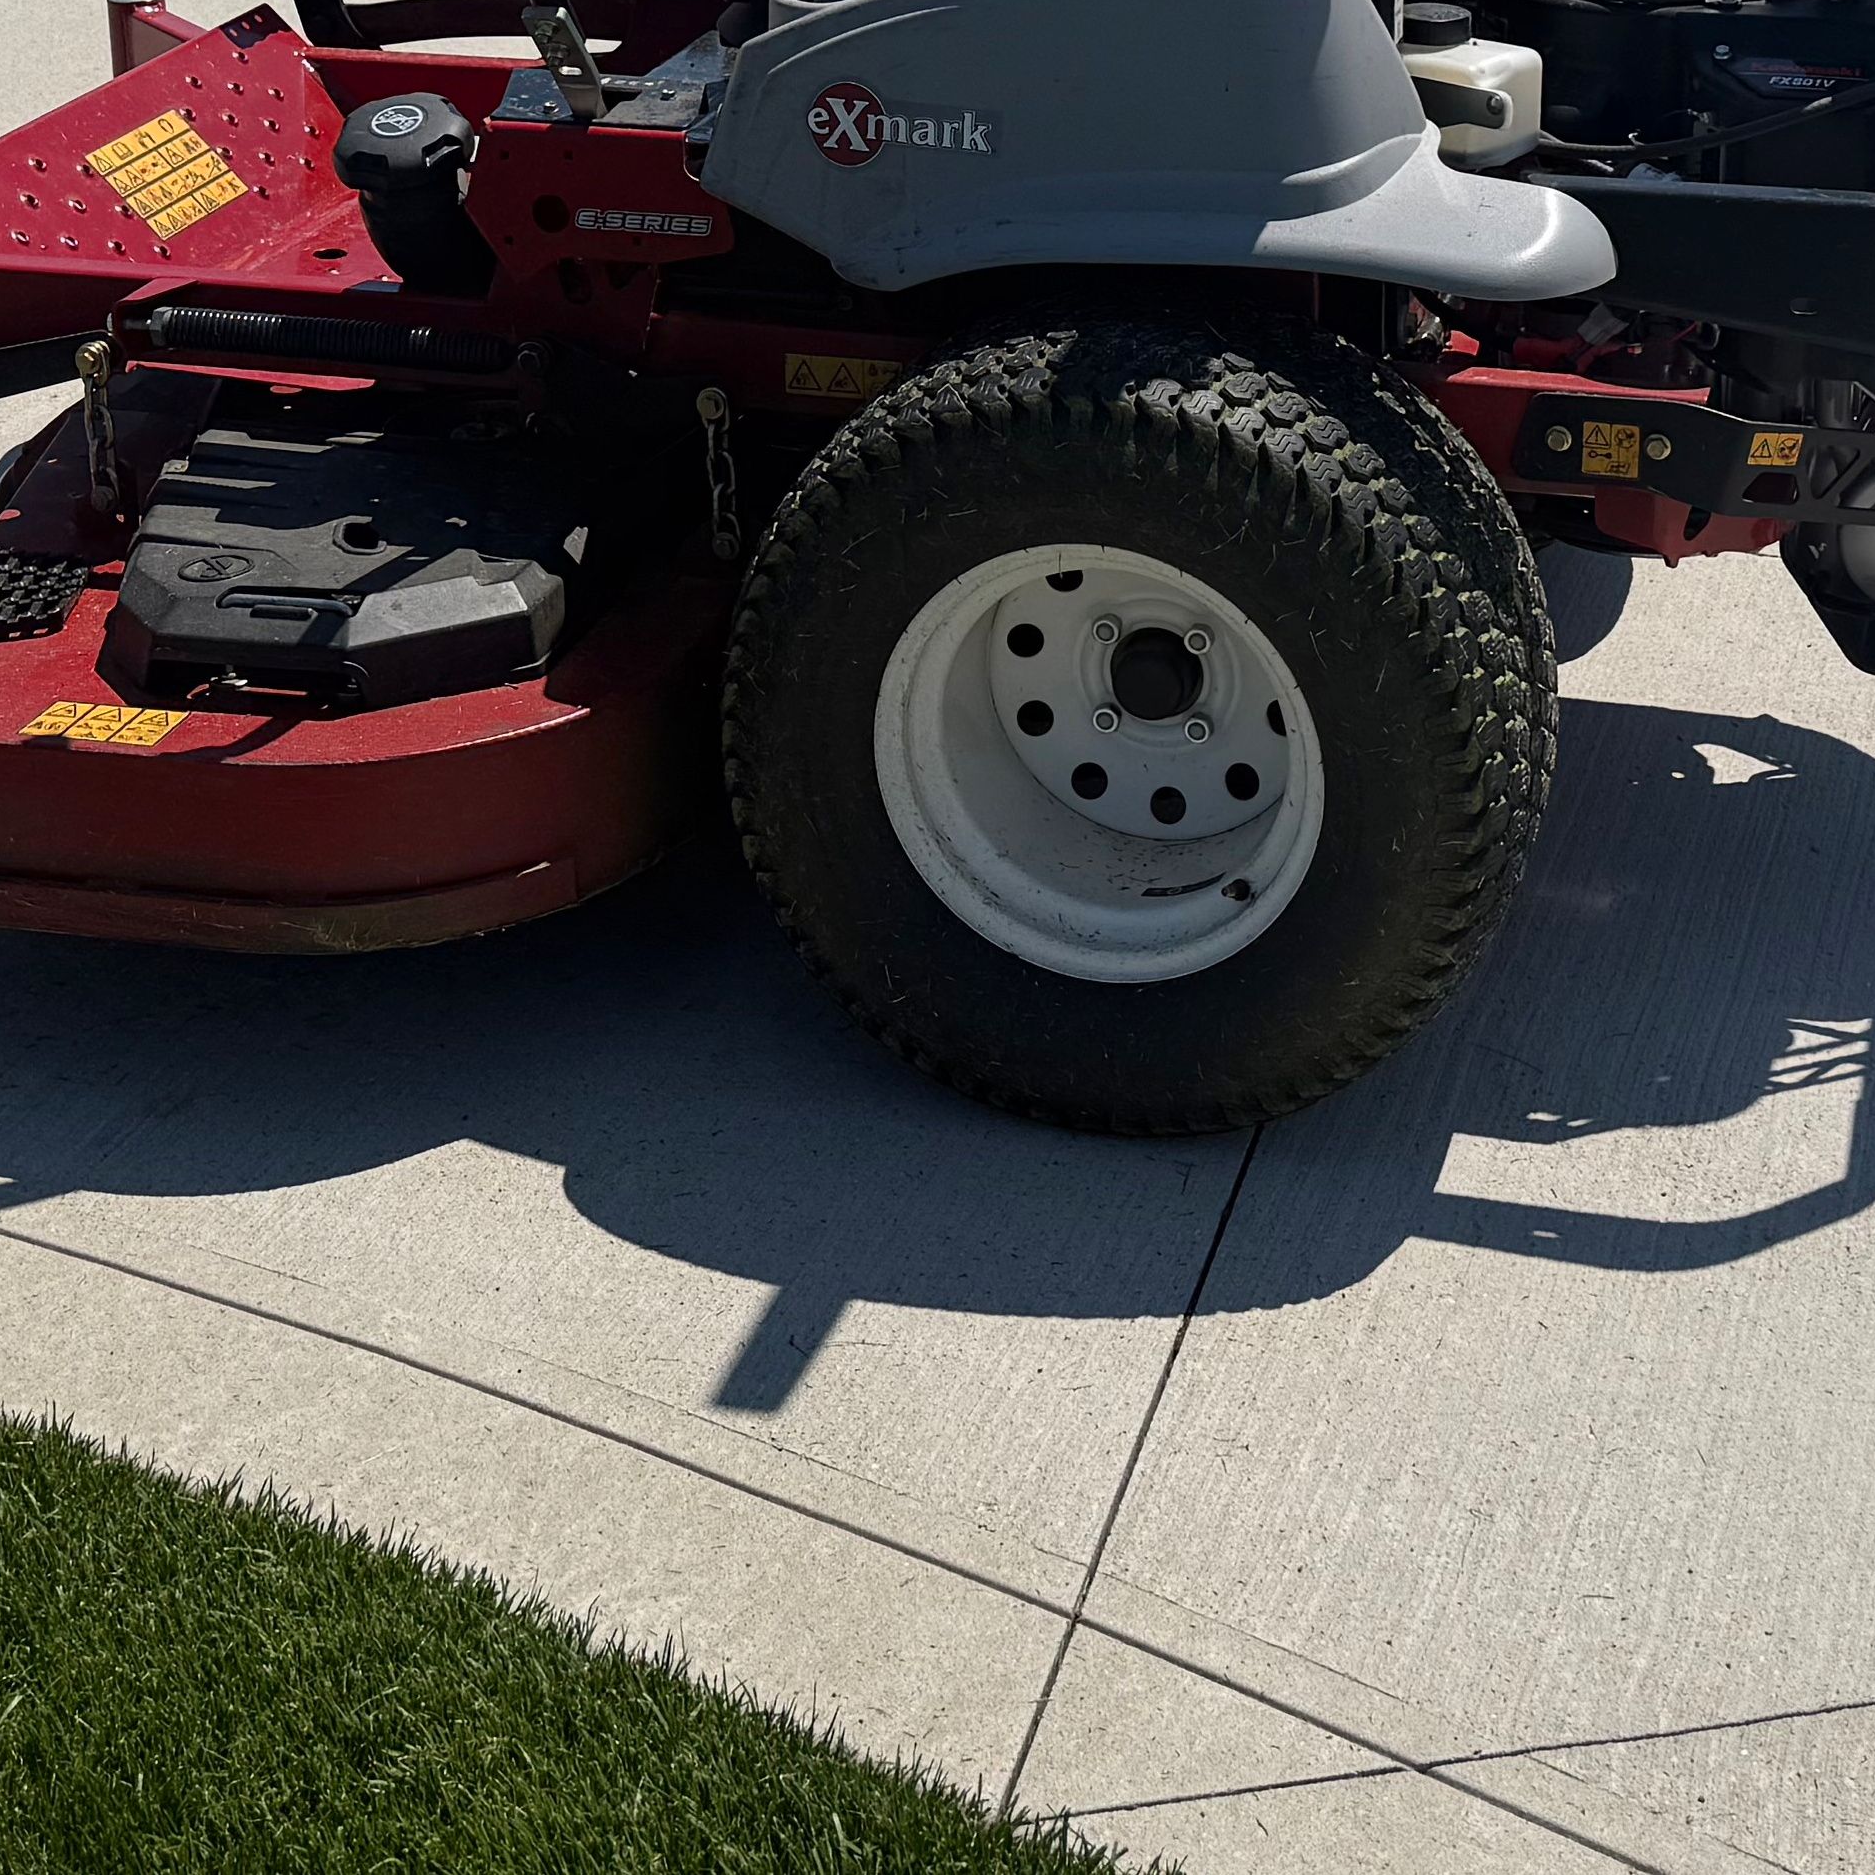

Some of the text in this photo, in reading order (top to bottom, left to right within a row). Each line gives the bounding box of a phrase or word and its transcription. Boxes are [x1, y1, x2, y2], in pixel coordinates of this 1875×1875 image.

[1769, 76, 1836, 88] FX801V
[806, 97, 992, 154] eXmark
[577, 211, 710, 234] E-SERIES
